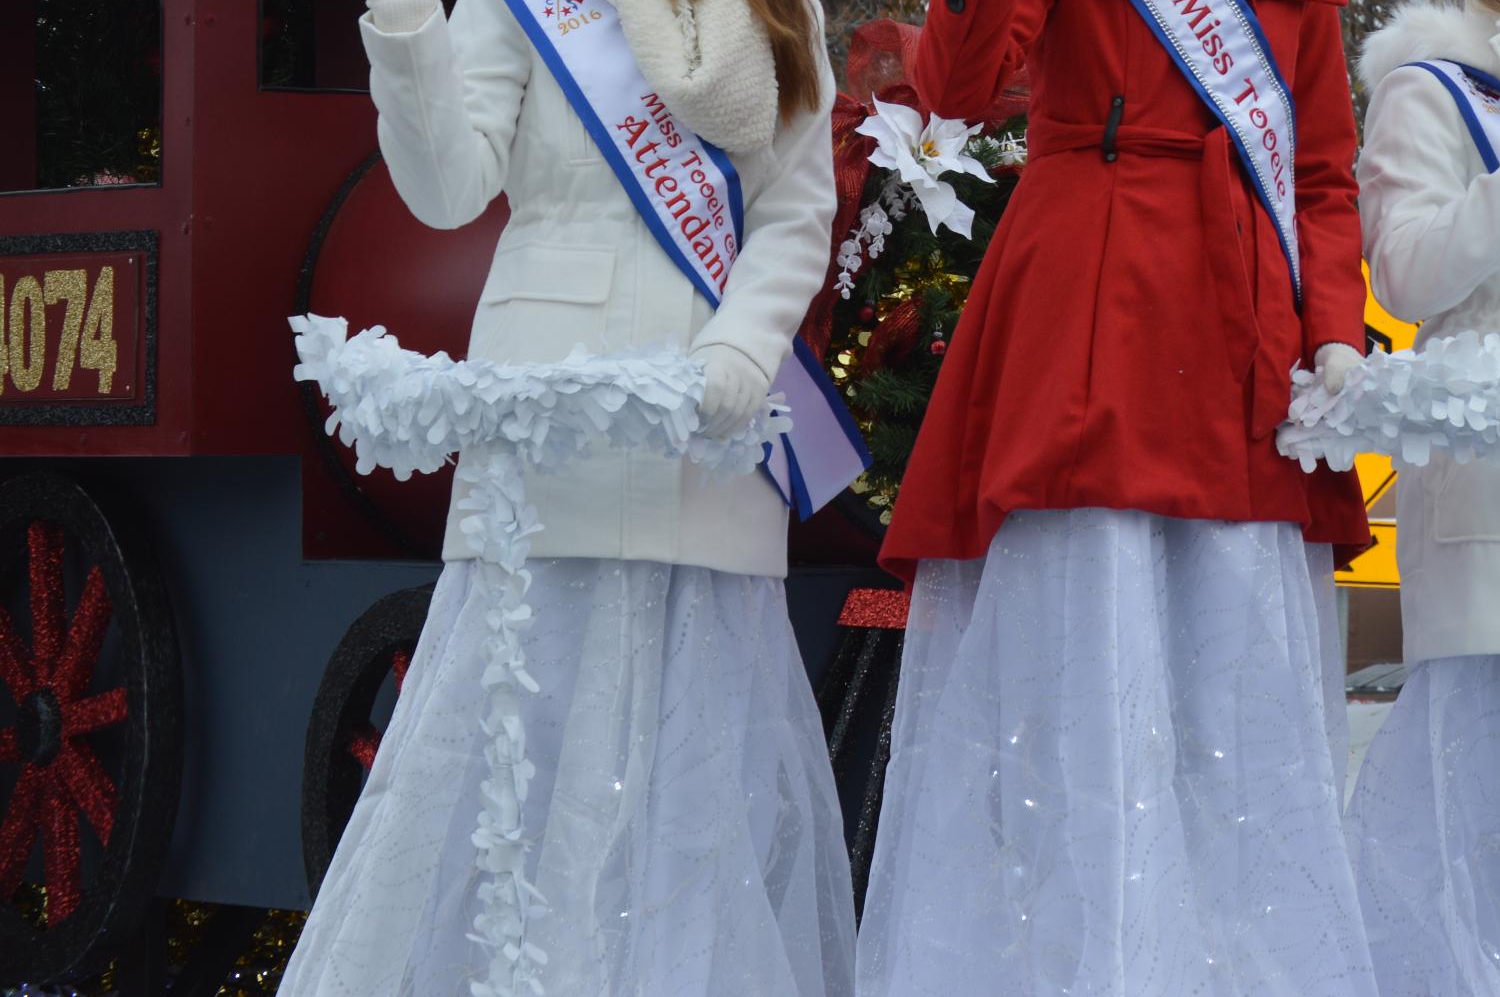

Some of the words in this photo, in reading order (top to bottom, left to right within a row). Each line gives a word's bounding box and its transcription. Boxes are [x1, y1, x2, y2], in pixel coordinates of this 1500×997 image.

[557, 9, 603, 36] 2016
[640, 92, 682, 149] Miss
[681, 150, 724, 230] Tooele
[1233, 77, 1287, 203] Tooele
[0, 265, 118, 395] 074
